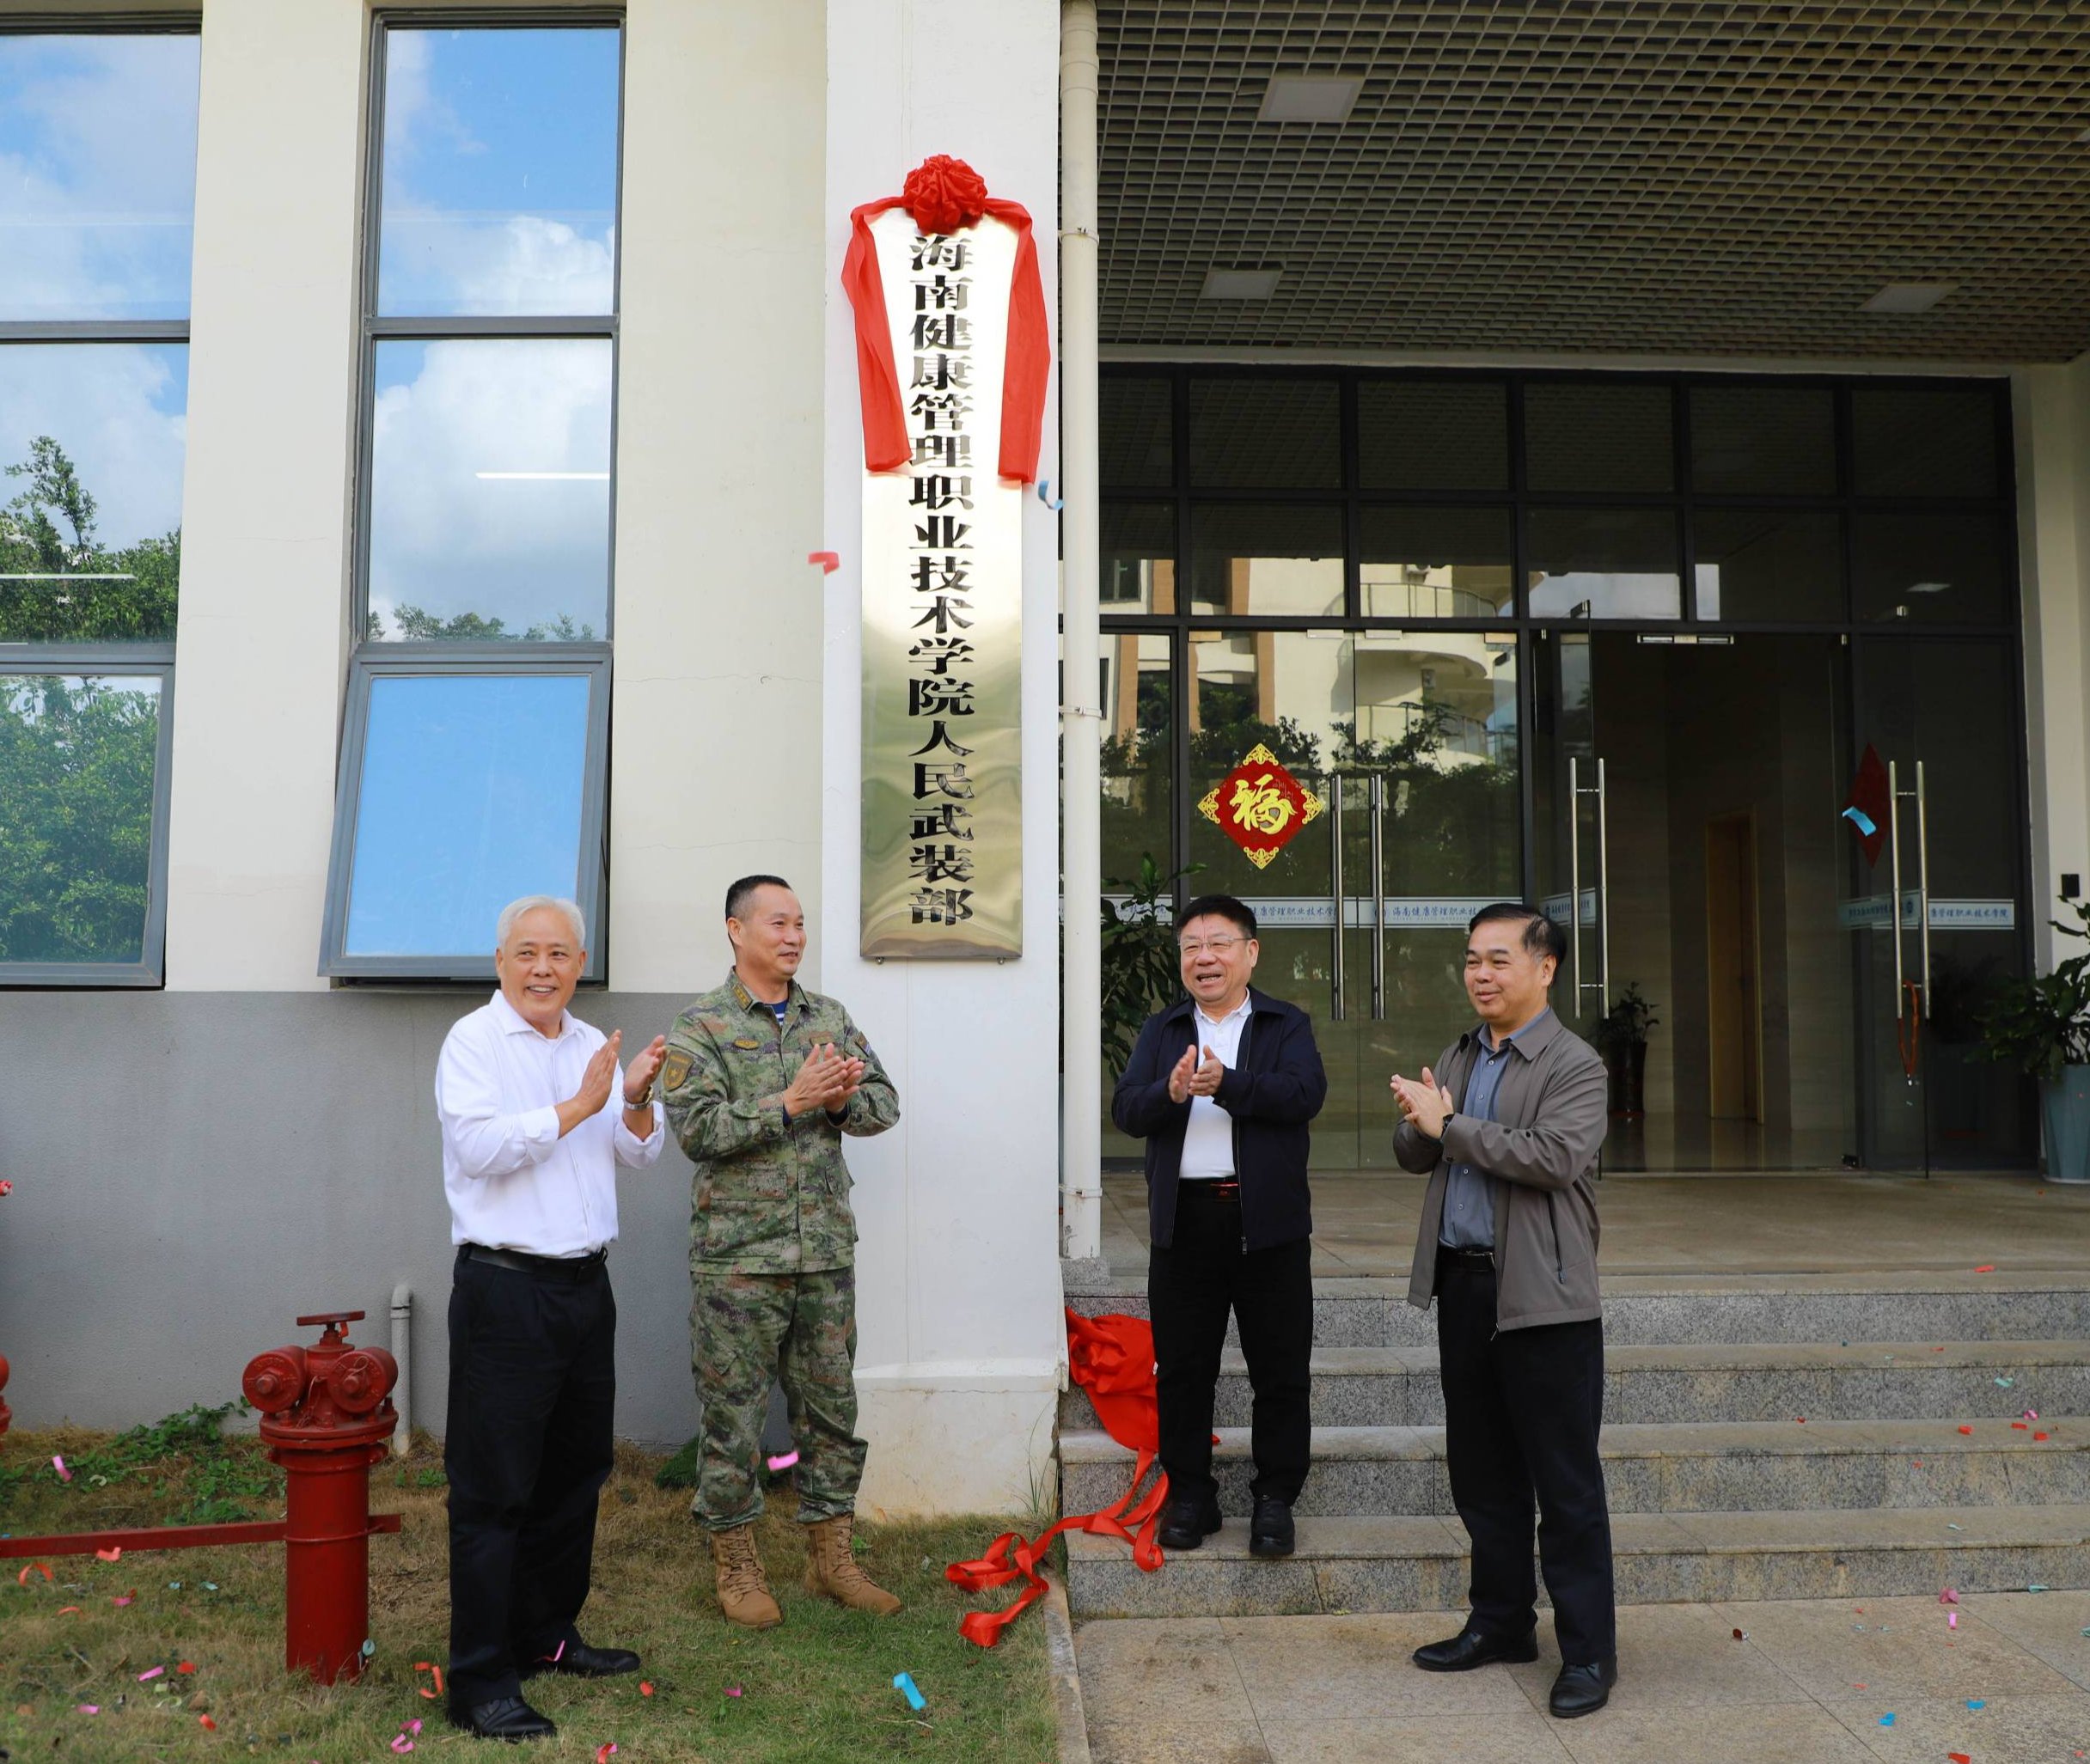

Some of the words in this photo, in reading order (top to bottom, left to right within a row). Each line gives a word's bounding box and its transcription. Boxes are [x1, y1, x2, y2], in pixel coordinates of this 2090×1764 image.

[908, 234, 975, 926] 海南健康管理职业技术学院人民武装部
[1229, 773, 1299, 834] 福
